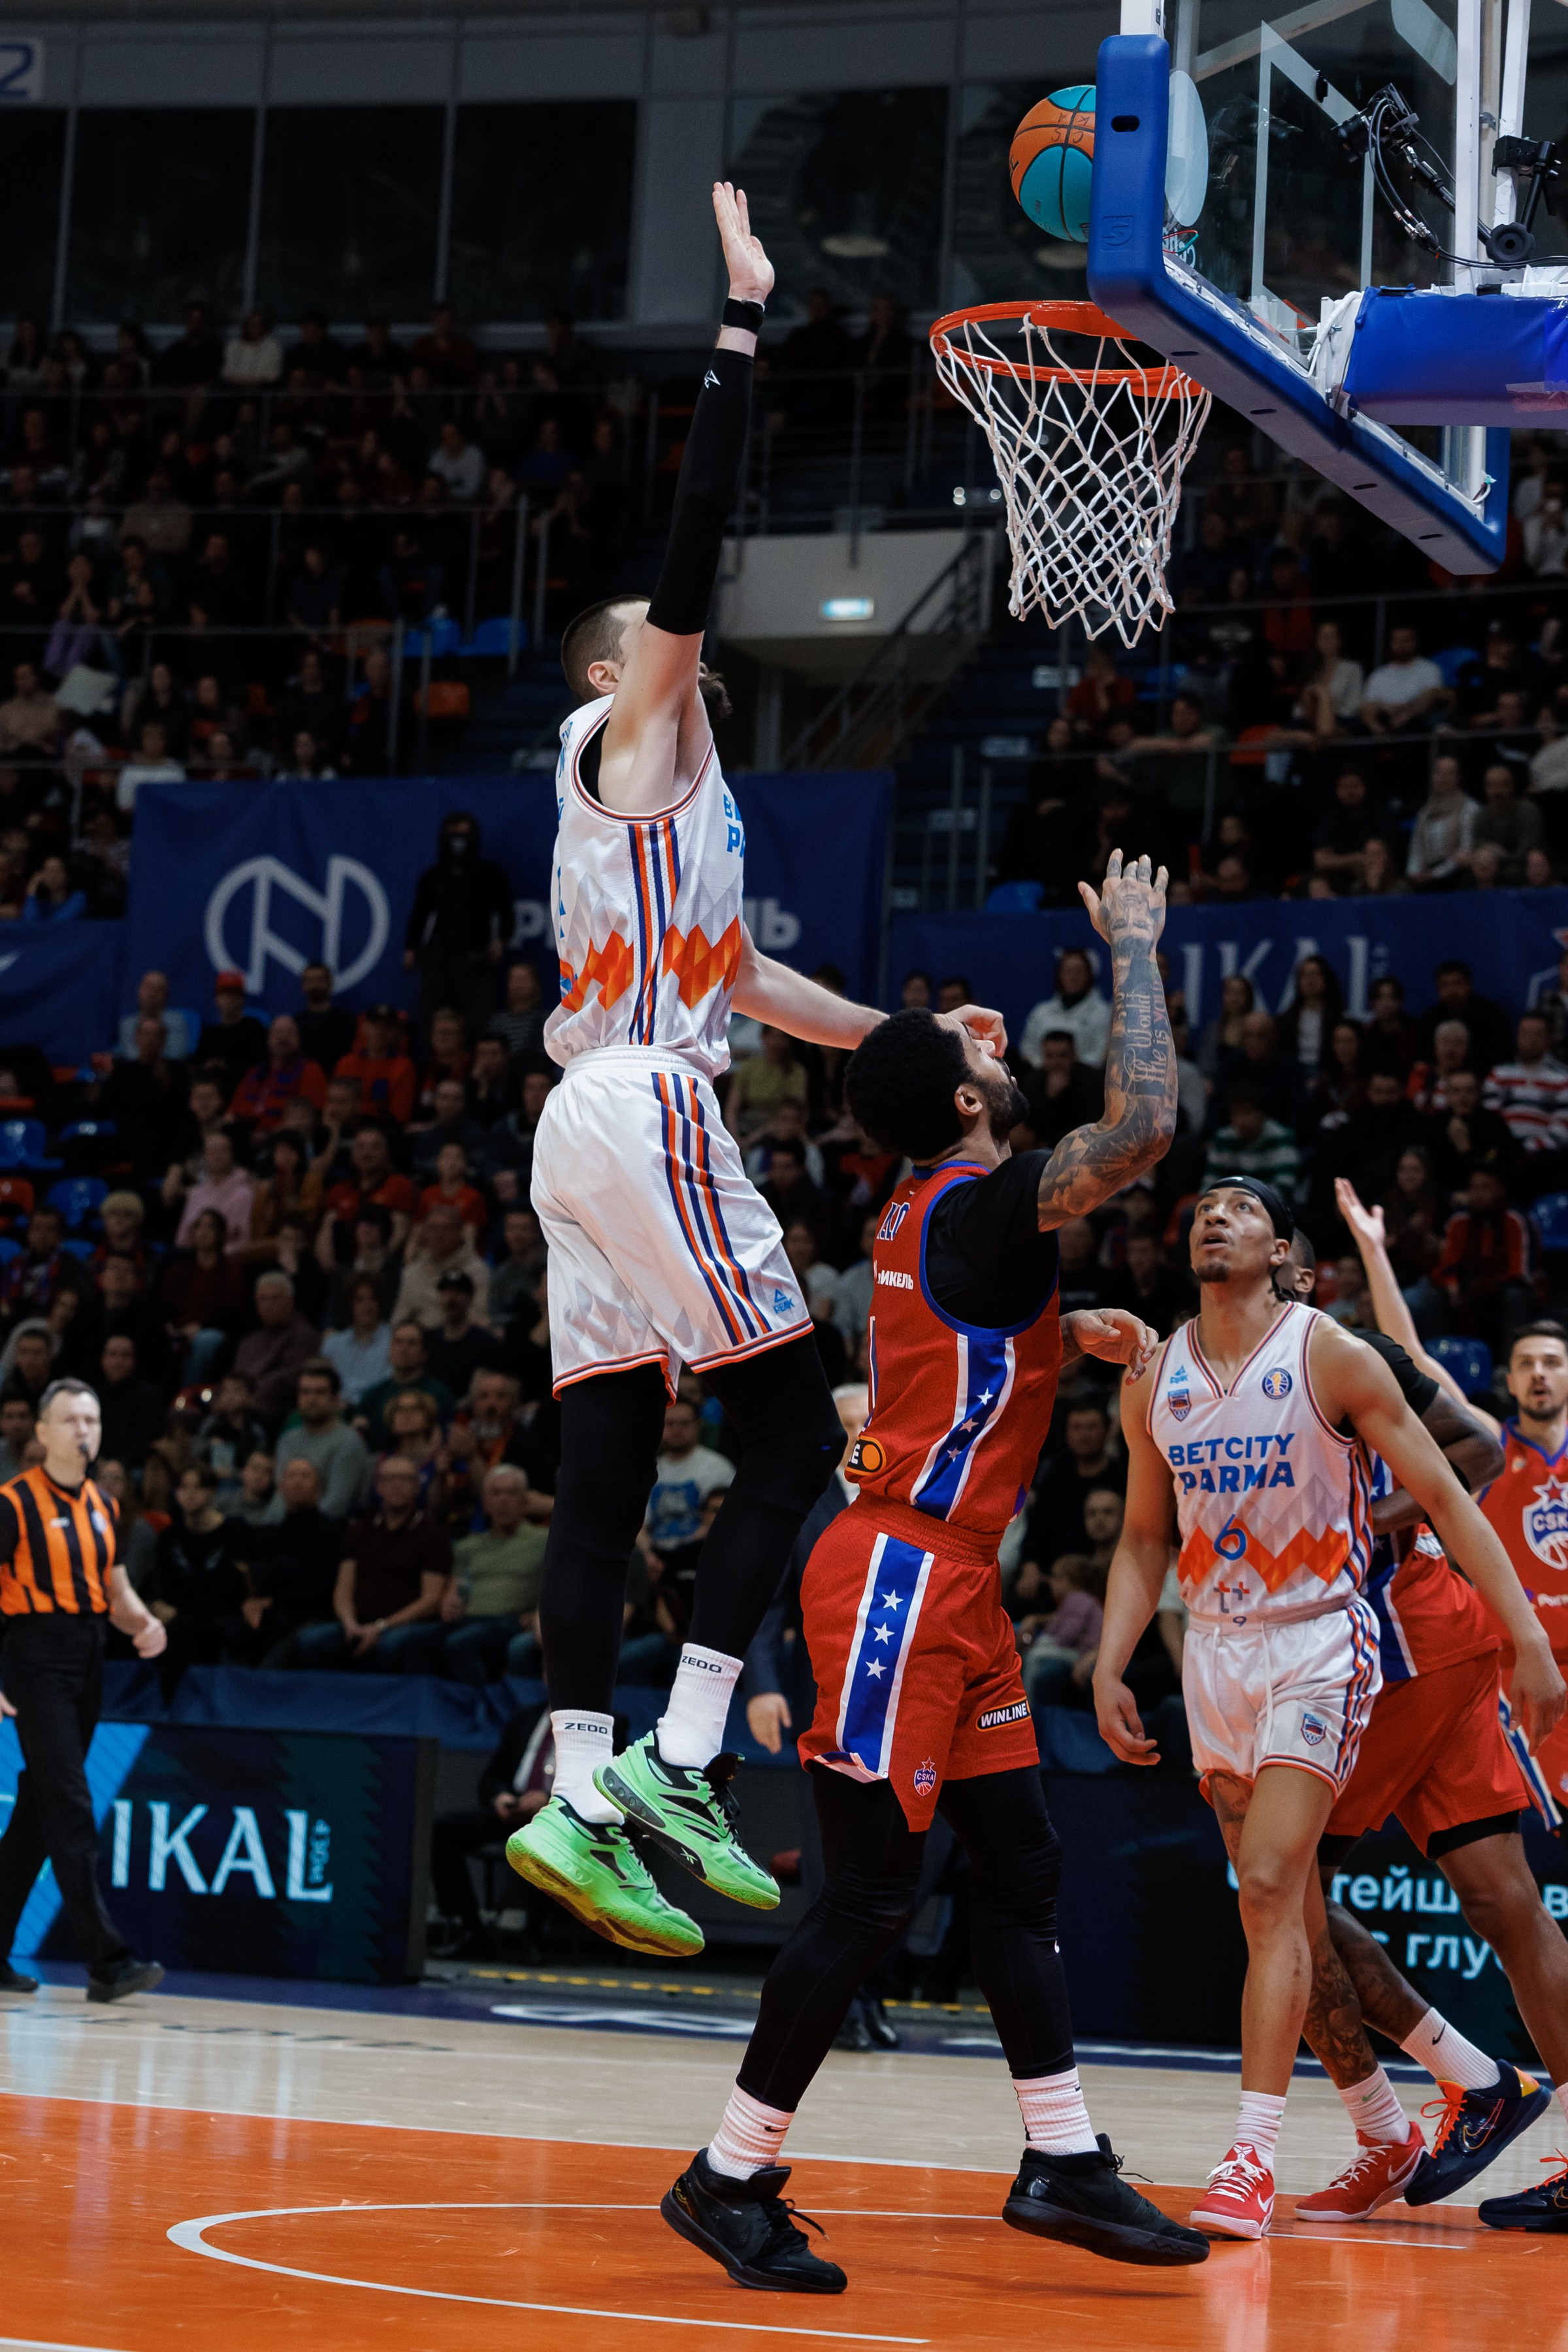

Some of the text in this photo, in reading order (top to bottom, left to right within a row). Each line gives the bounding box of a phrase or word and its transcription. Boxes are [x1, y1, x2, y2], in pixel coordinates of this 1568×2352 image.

[1168, 1433, 1295, 1466] BETCITY
[1178, 1462, 1295, 1495] PARMA
[1213, 1513, 1247, 1560] 6
[1533, 1512, 1568, 1532] CSK
[981, 1703, 1027, 1727] WINLINE
